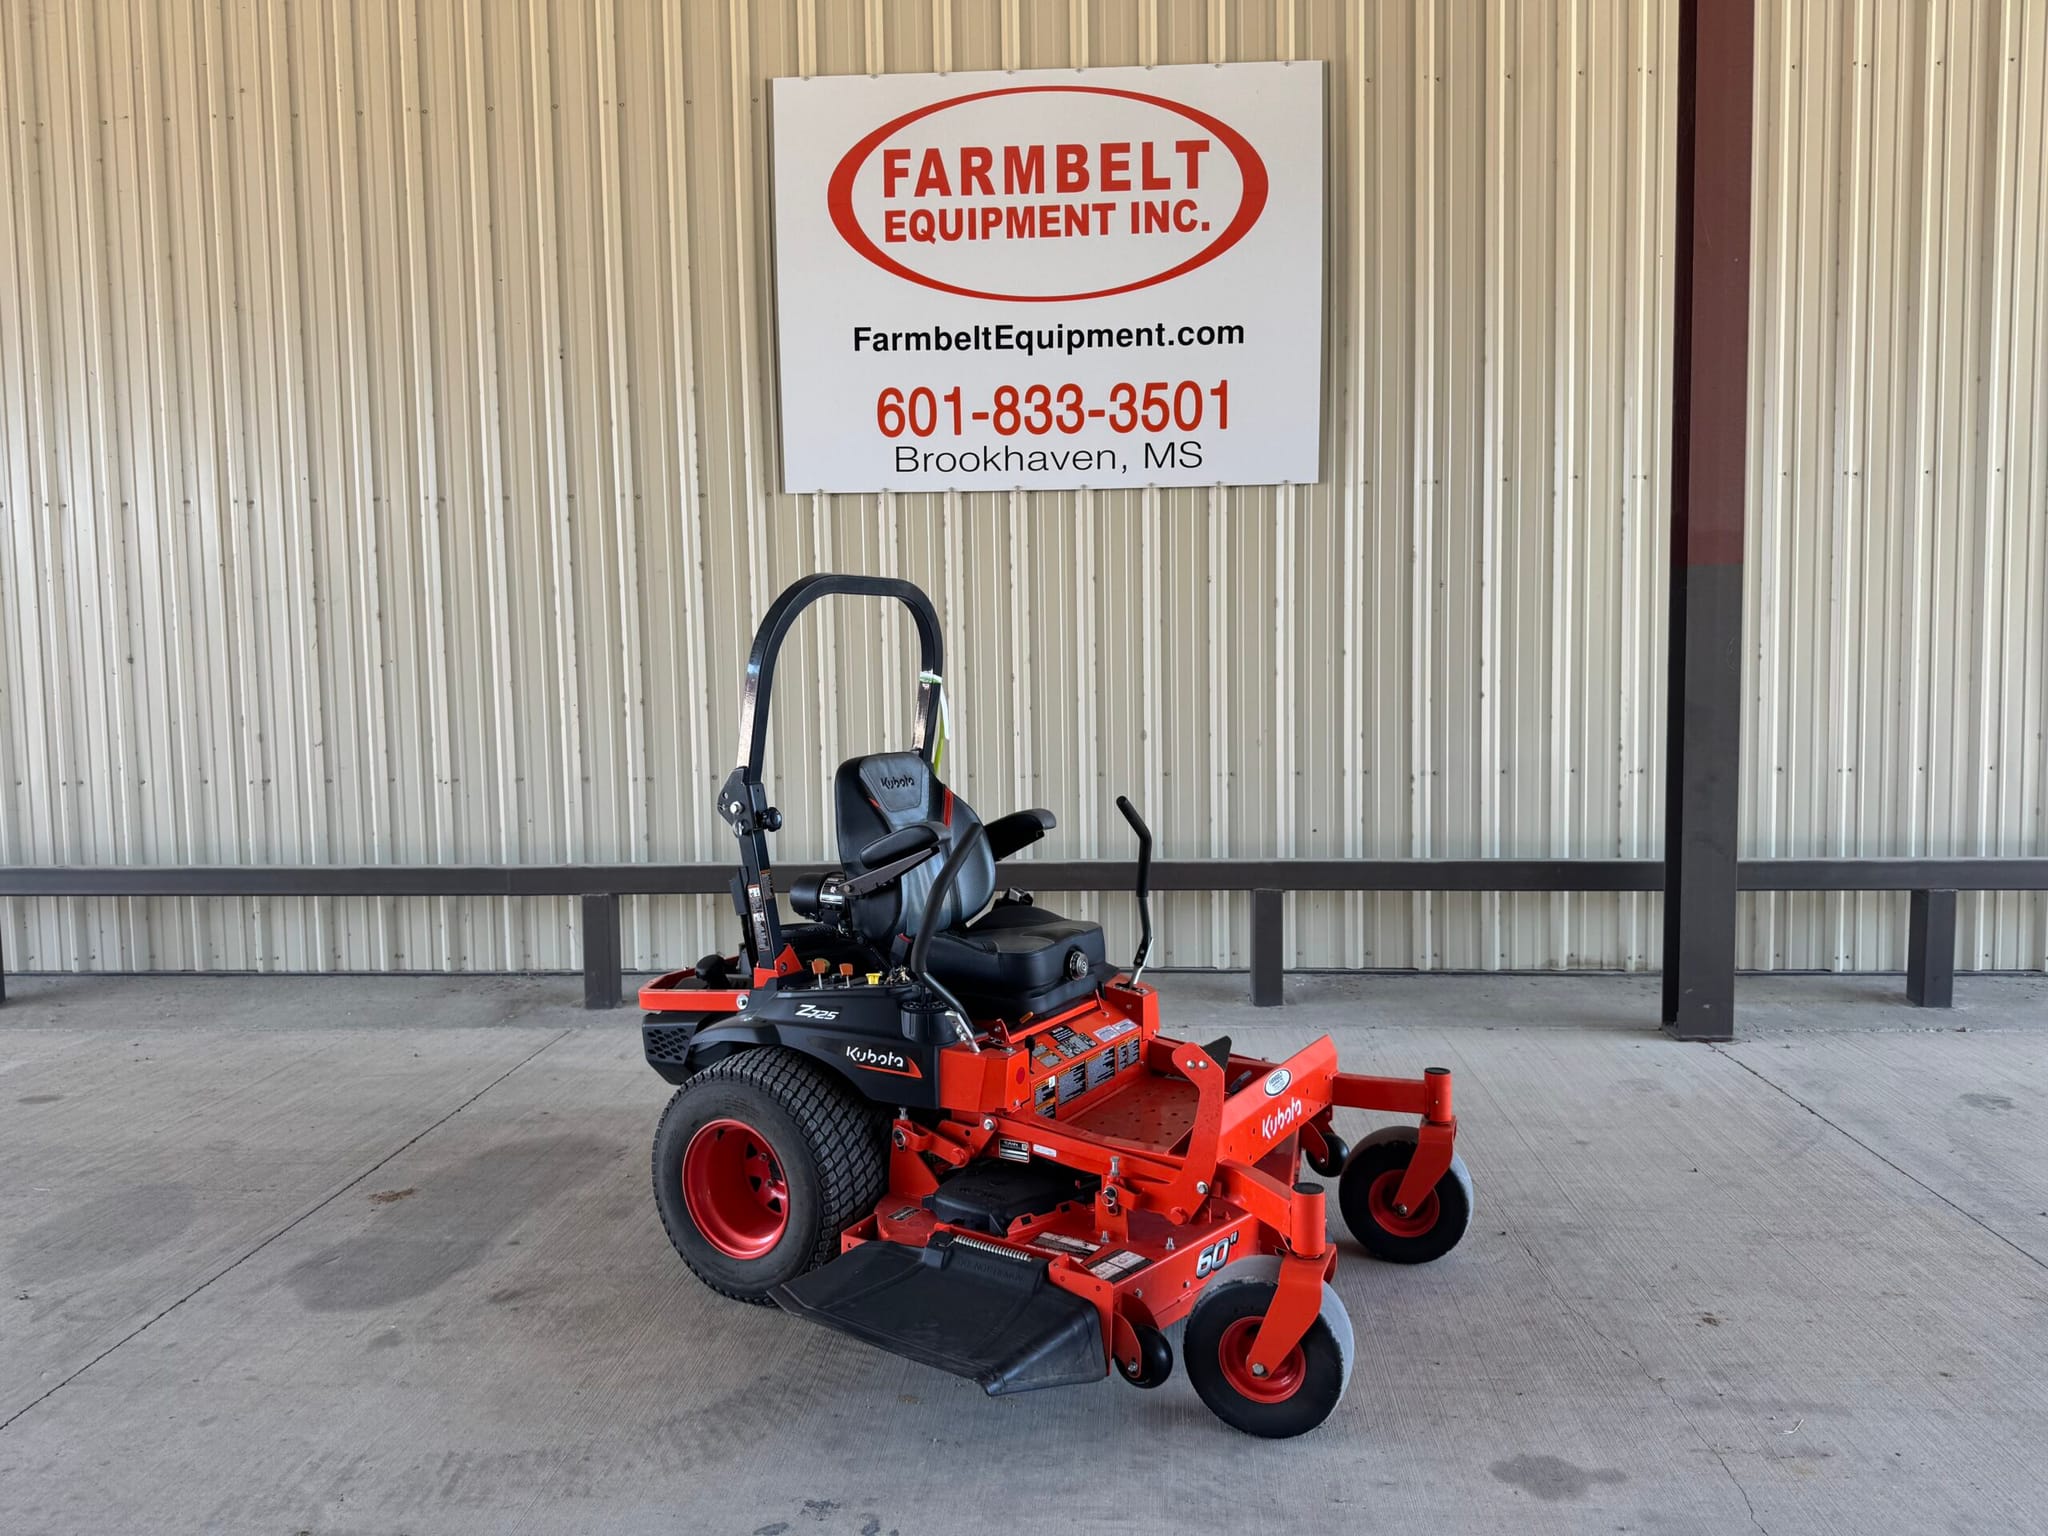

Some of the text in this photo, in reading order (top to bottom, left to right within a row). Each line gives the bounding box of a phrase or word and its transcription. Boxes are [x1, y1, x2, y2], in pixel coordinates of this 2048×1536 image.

[882, 139, 1211, 198] FARMBELT
[884, 199, 1211, 244] EQUIPMENT INC.
[854, 323, 1245, 356] FarmbeltEquipment.com
[876, 379, 1229, 438] 601-833-3501
[895, 440, 1203, 474] Brookhaven, MS
[880, 775, 915, 790] Kubota
[795, 1004, 839, 1020] Z725
[846, 1046, 904, 1067] Kubota
[1262, 1097, 1302, 1140] Kubota
[1196, 1230, 1239, 1279] 60"
